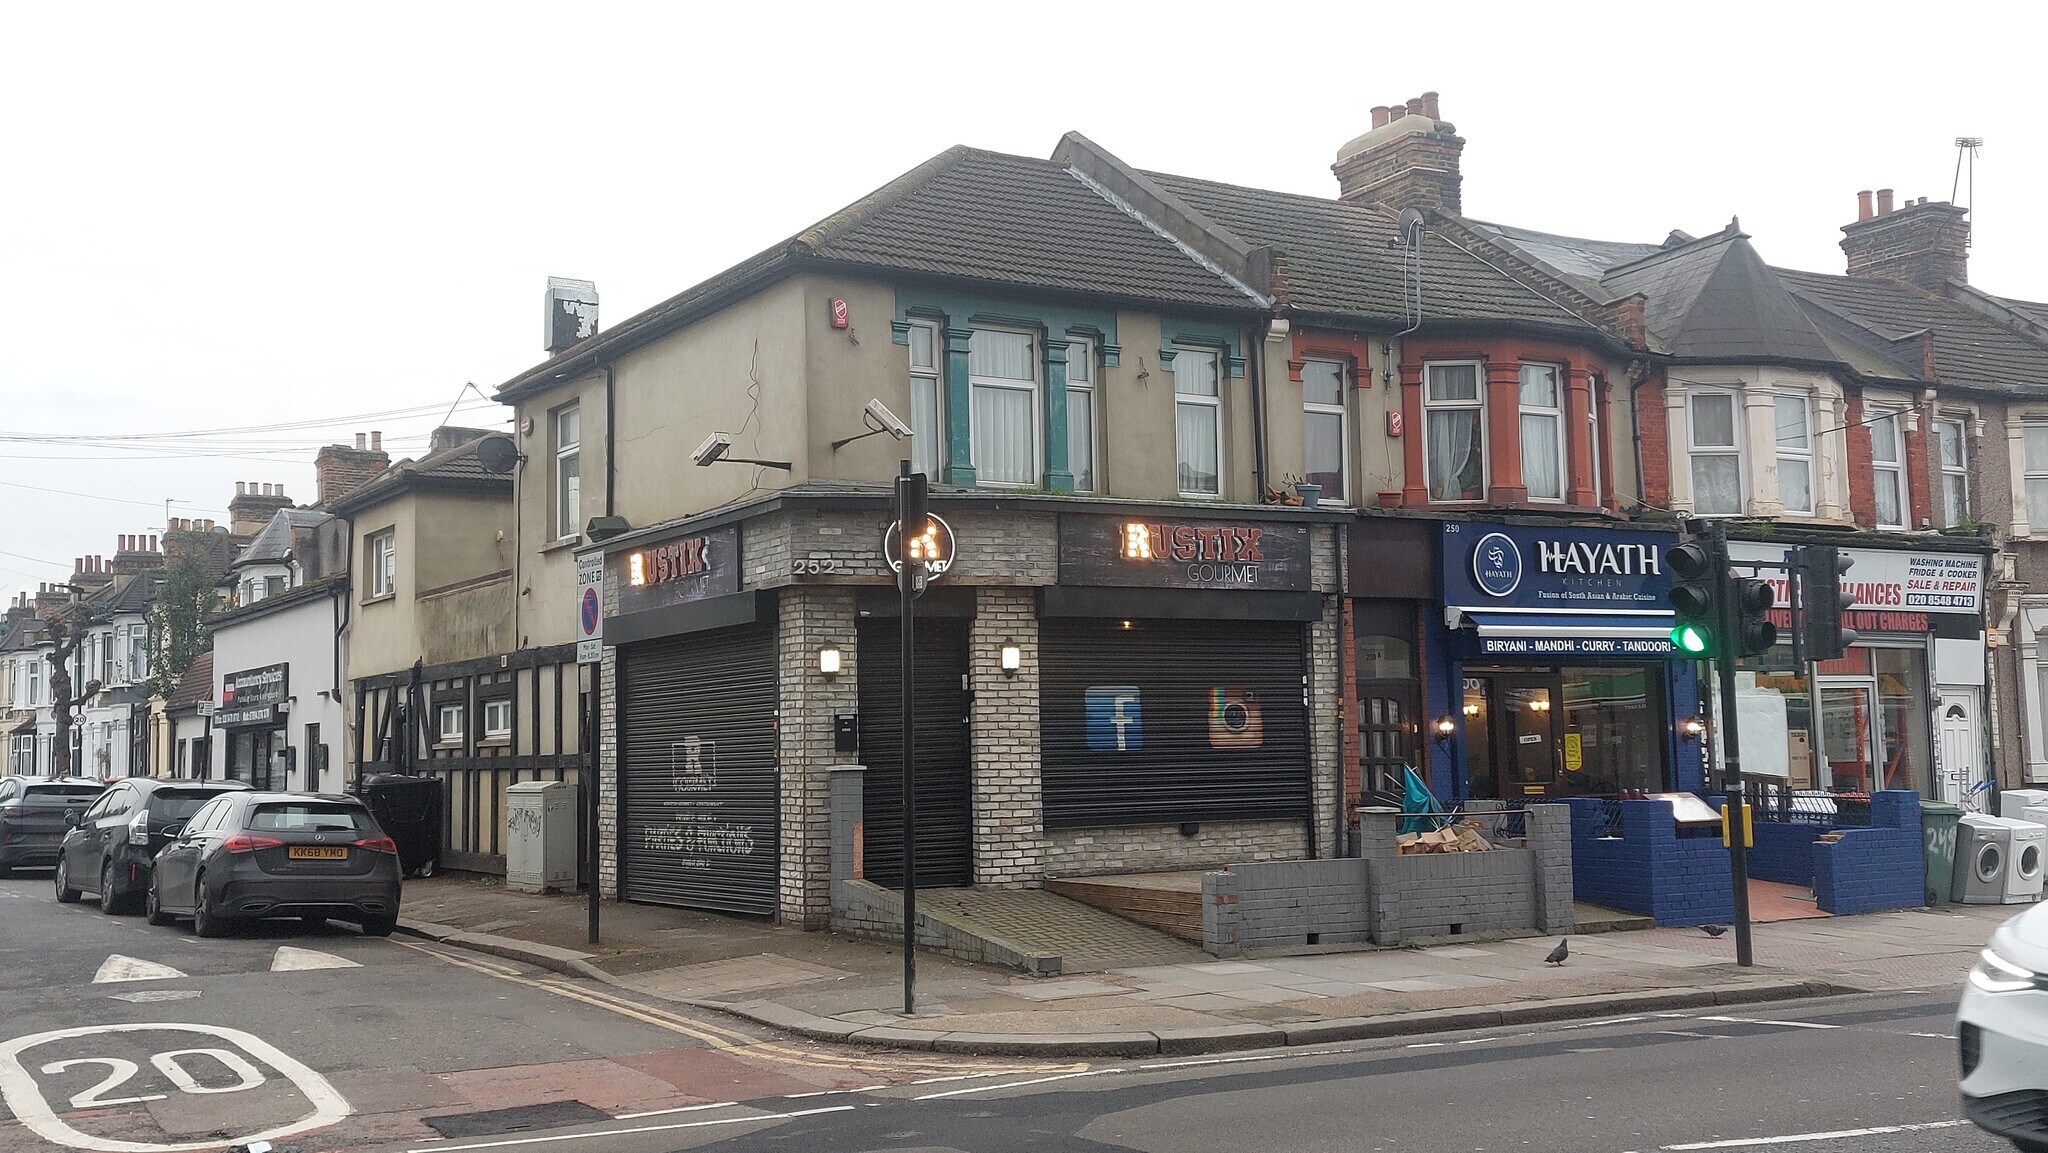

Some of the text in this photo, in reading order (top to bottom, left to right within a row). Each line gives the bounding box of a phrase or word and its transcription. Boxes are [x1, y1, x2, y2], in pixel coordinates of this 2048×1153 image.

[1445, 524, 1460, 533] 250
[1122, 524, 1264, 562] RUSTIX
[579, 555, 602, 570] Controlled
[1538, 540, 1661, 575] HAYATH
[1909, 557, 1978, 569] WASHING MACHINE
[793, 559, 836, 575] 252
[893, 560, 947, 573] GMET
[579, 571, 595, 585] ZONE
[1187, 564, 1260, 583] GOURMET
[1484, 570, 1512, 578] HAYATH
[1908, 568, 1978, 579] FRIDGE & COOKER
[1562, 578, 1621, 587] KITCHEN
[1907, 580, 1977, 592] SALE & REPAIR
[1538, 590, 1560, 599] Fusion
[1560, 591, 1568, 599] of
[1568, 591, 1586, 600] South
[1587, 592, 1605, 600] Asian
[1612, 592, 1632, 600] Arabic
[1633, 593, 1656, 601] Cuisine
[1908, 594, 1926, 605] 020
[1952, 596, 1973, 607] 4713
[1856, 612, 1877, 630] OUT
[1880, 612, 1928, 631] CHARGES
[1486, 640, 1527, 652] BIRYANI
[1535, 640, 1575, 651] MANDHI
[1582, 640, 1615, 651] CURRY
[1622, 640, 1671, 652] TANDOORI
[41, 1049, 266, 1108] 20
